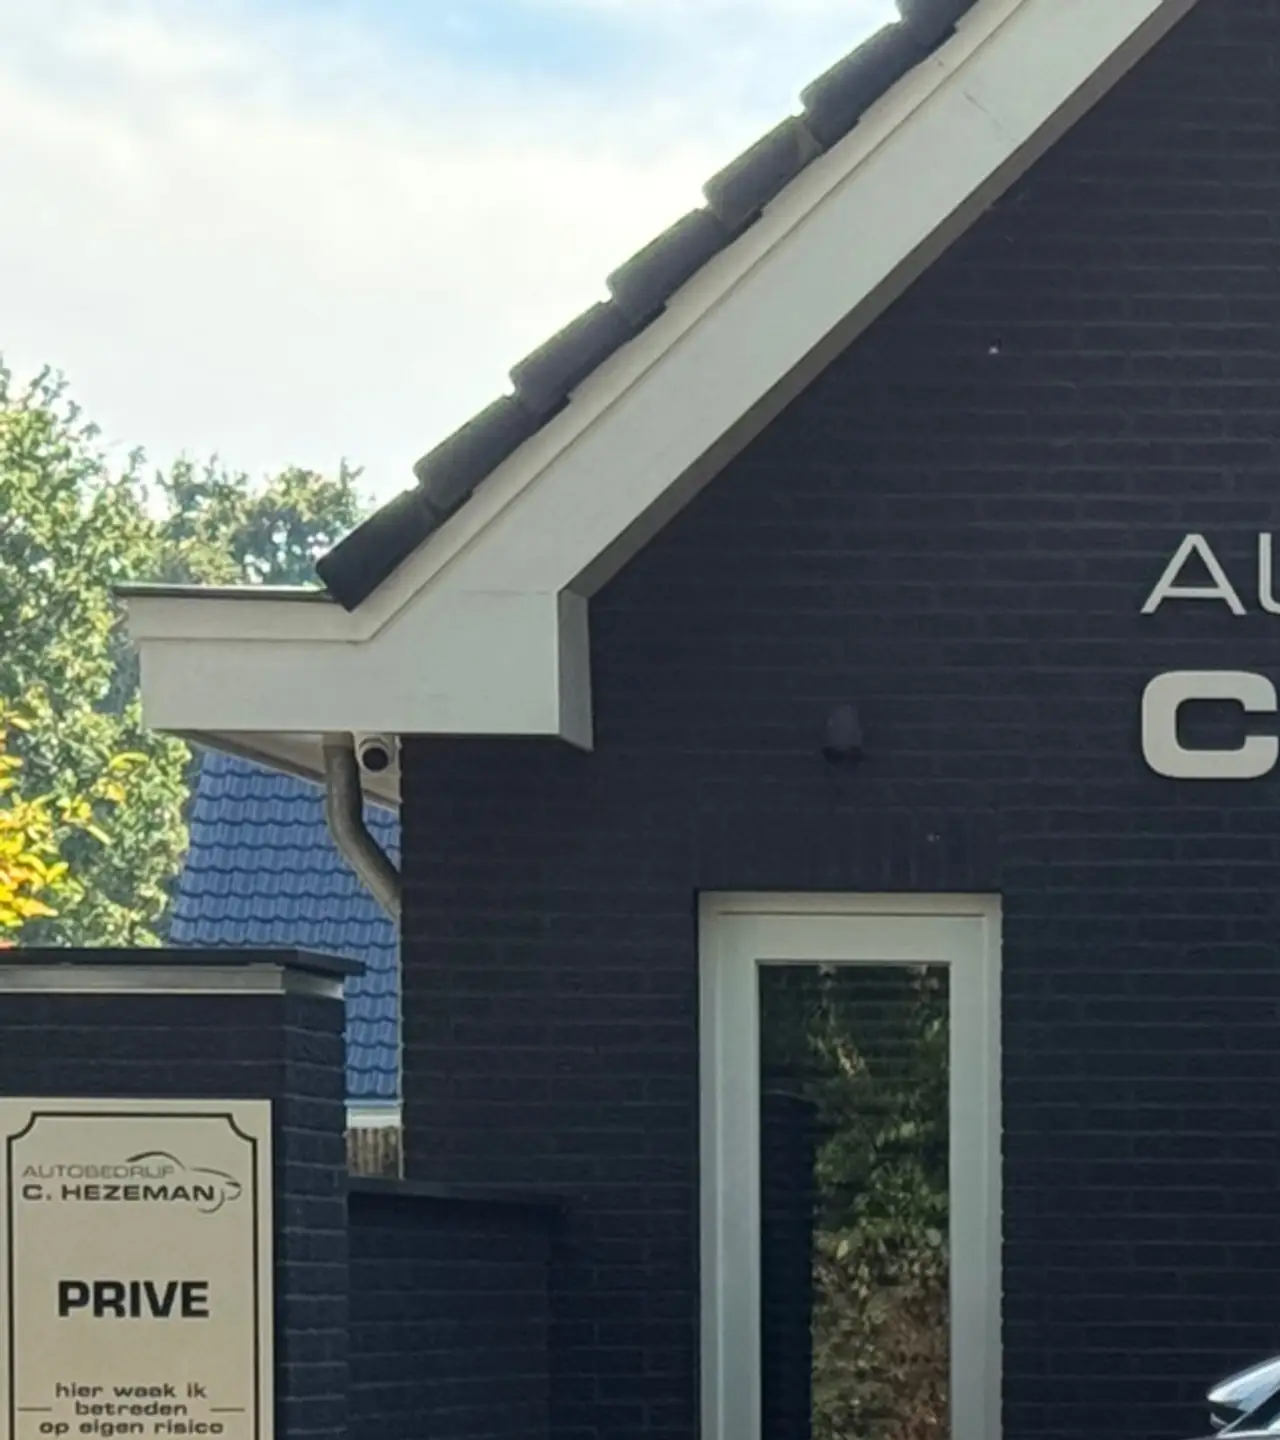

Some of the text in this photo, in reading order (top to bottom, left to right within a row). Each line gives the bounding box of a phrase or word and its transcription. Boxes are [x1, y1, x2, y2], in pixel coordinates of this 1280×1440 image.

[22, 1164, 175, 1179] AUTOBEDRIJF
[22, 1184, 214, 1201] C. HEZEMAN
[58, 1280, 209, 1318] PRIVE
[55, 1382, 207, 1398] hier waak ik
[75, 1400, 188, 1416] betreden
[39, 1419, 224, 1437] op eigen risico
